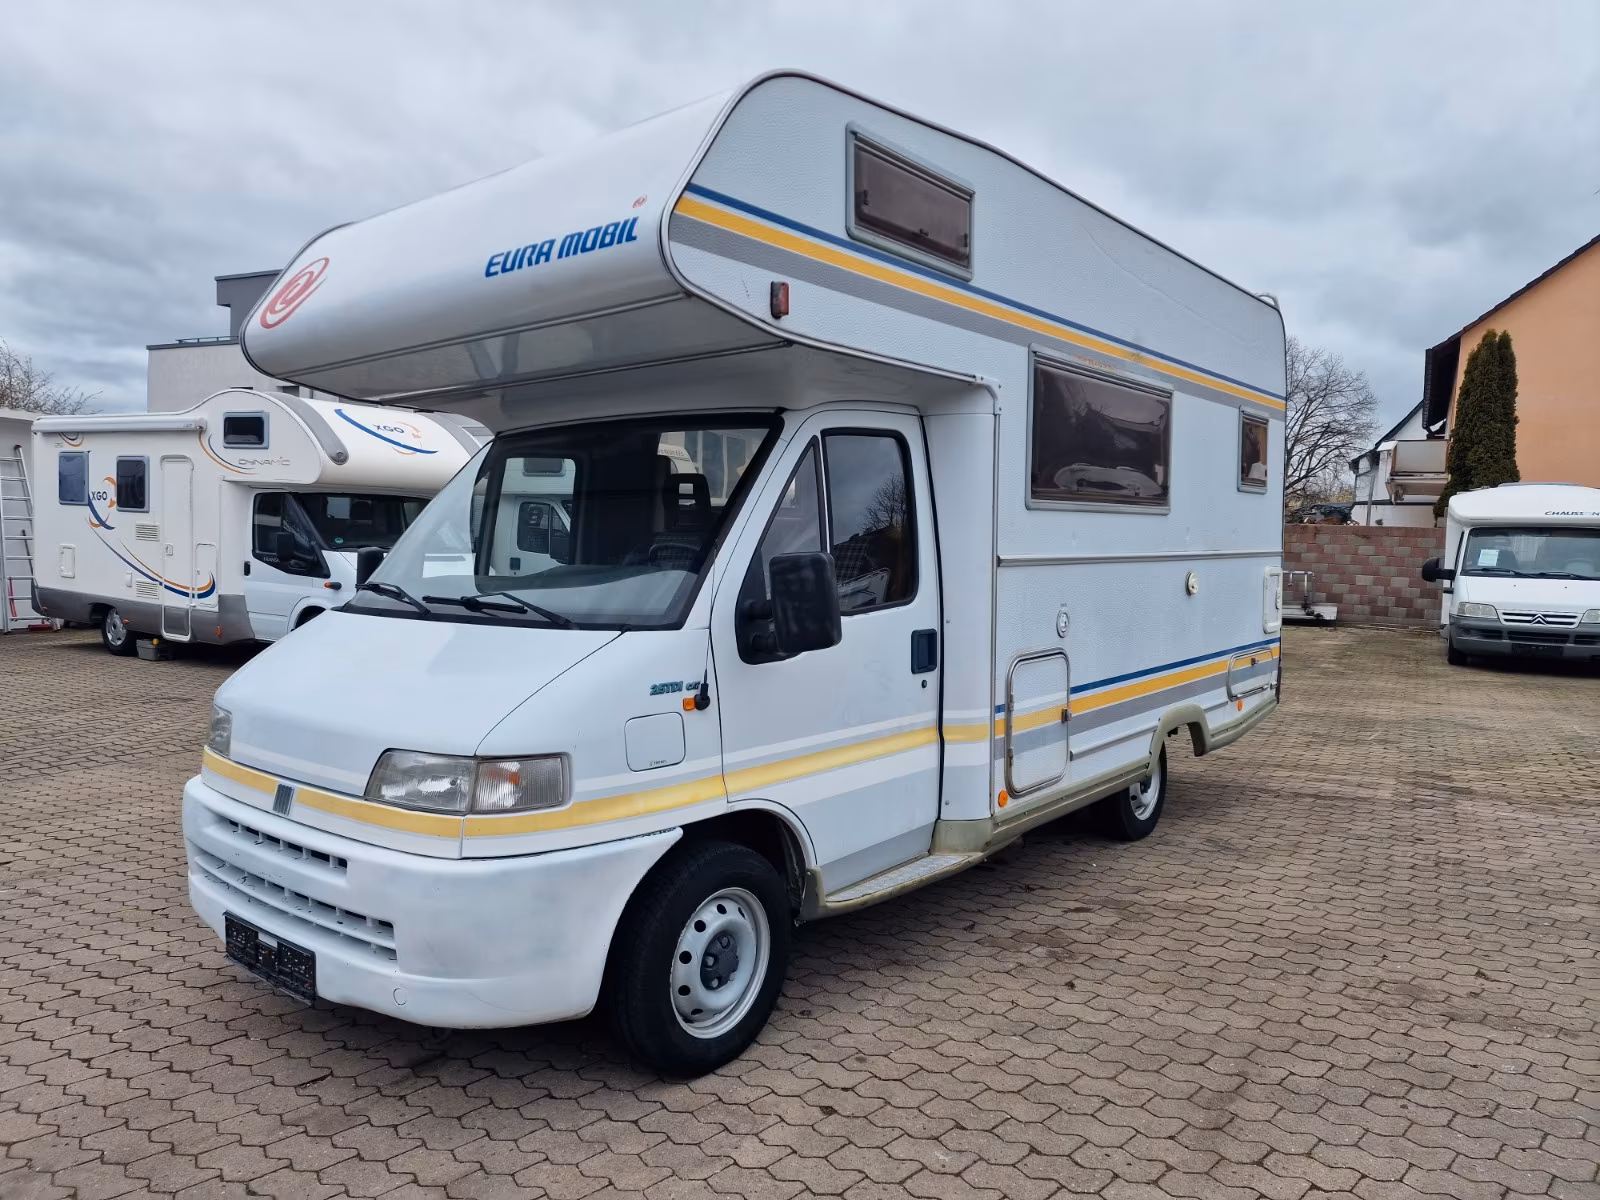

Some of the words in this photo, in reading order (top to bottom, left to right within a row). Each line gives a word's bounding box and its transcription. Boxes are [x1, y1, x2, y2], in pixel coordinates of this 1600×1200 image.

[485, 238, 556, 278] EURA
[557, 216, 639, 260] MOBIL
[373, 424, 404, 433] XGO
[91, 491, 107, 501] XGO
